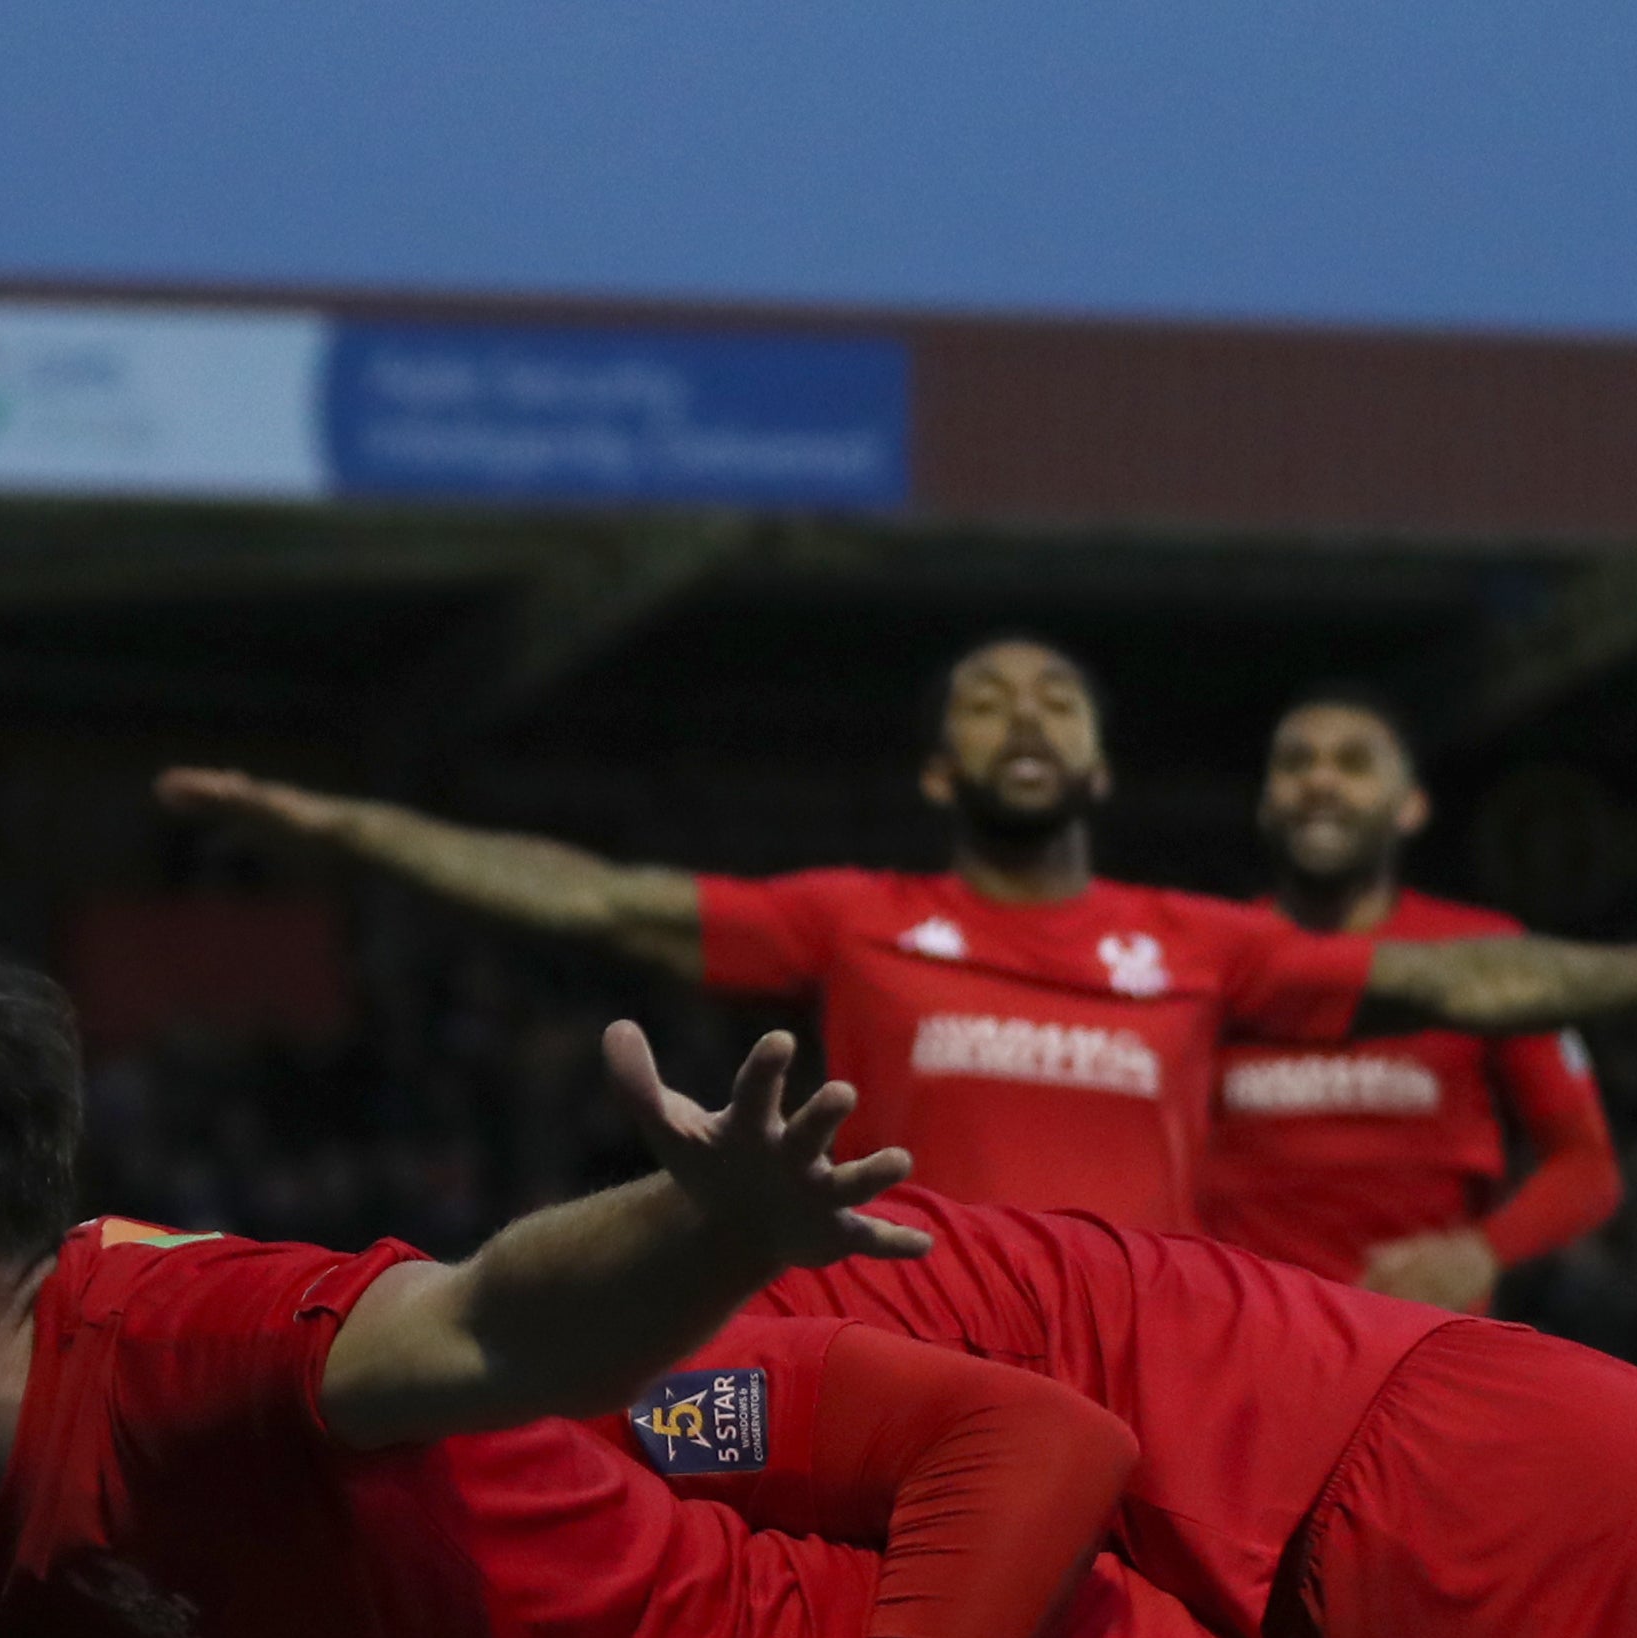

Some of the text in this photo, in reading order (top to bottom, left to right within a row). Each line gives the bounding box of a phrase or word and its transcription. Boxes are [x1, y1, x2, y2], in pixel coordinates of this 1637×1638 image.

[652, 1404, 703, 1437] 5
[714, 1375, 739, 1462] 5 STAR
[738, 1397, 750, 1448] WINDOWS
[750, 1372, 764, 1462] CONSERVATORIES
